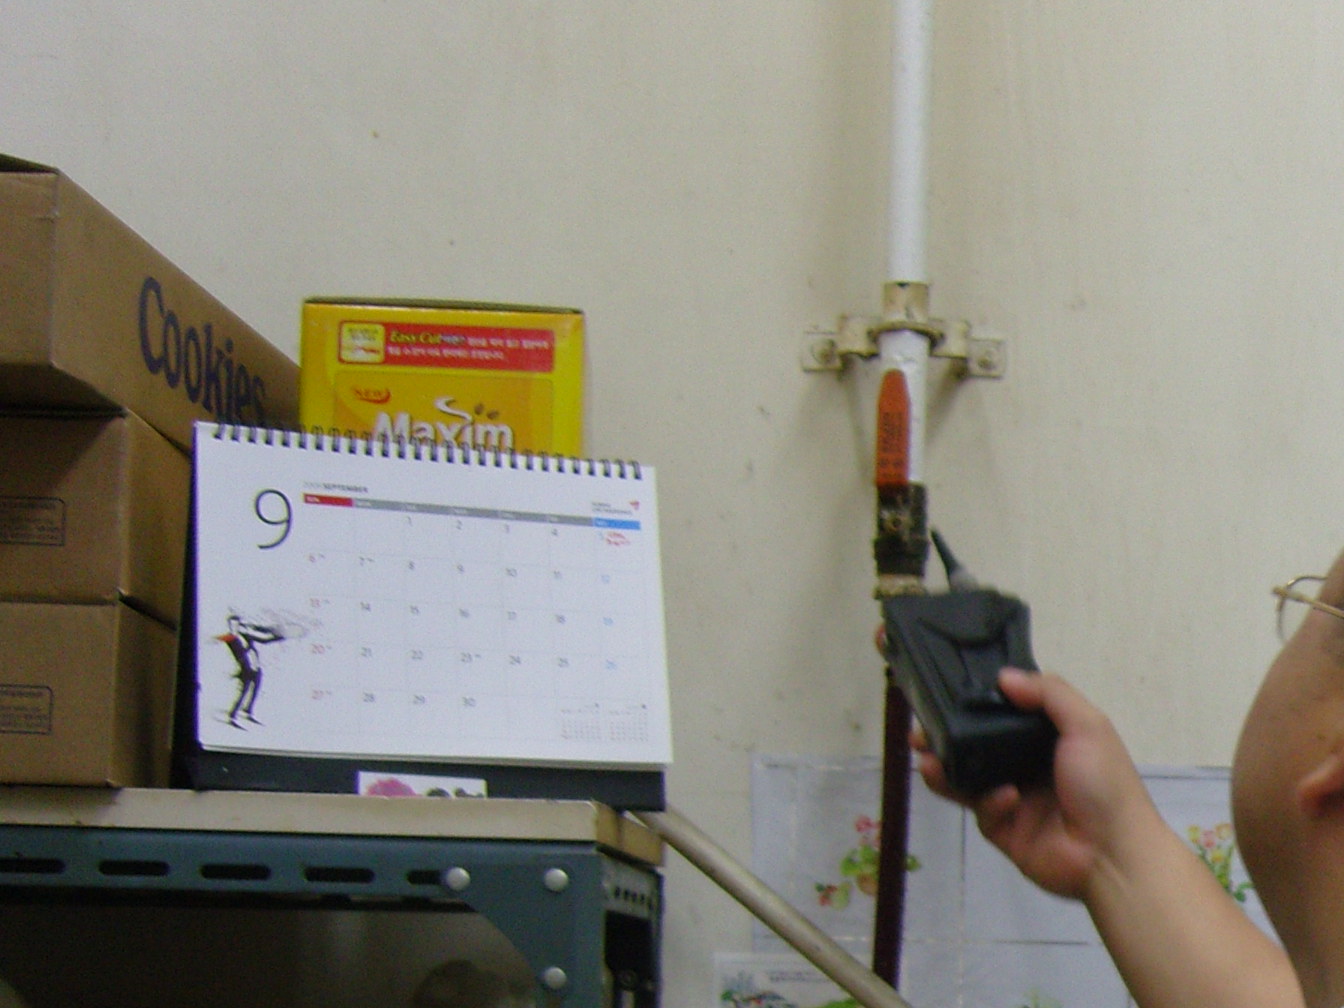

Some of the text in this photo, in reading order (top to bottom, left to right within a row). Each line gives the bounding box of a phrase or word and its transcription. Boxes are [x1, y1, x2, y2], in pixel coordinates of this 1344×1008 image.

[139, 276, 266, 424] Cookies
[373, 402, 514, 449] Maxim
[254, 488, 293, 550] 9
